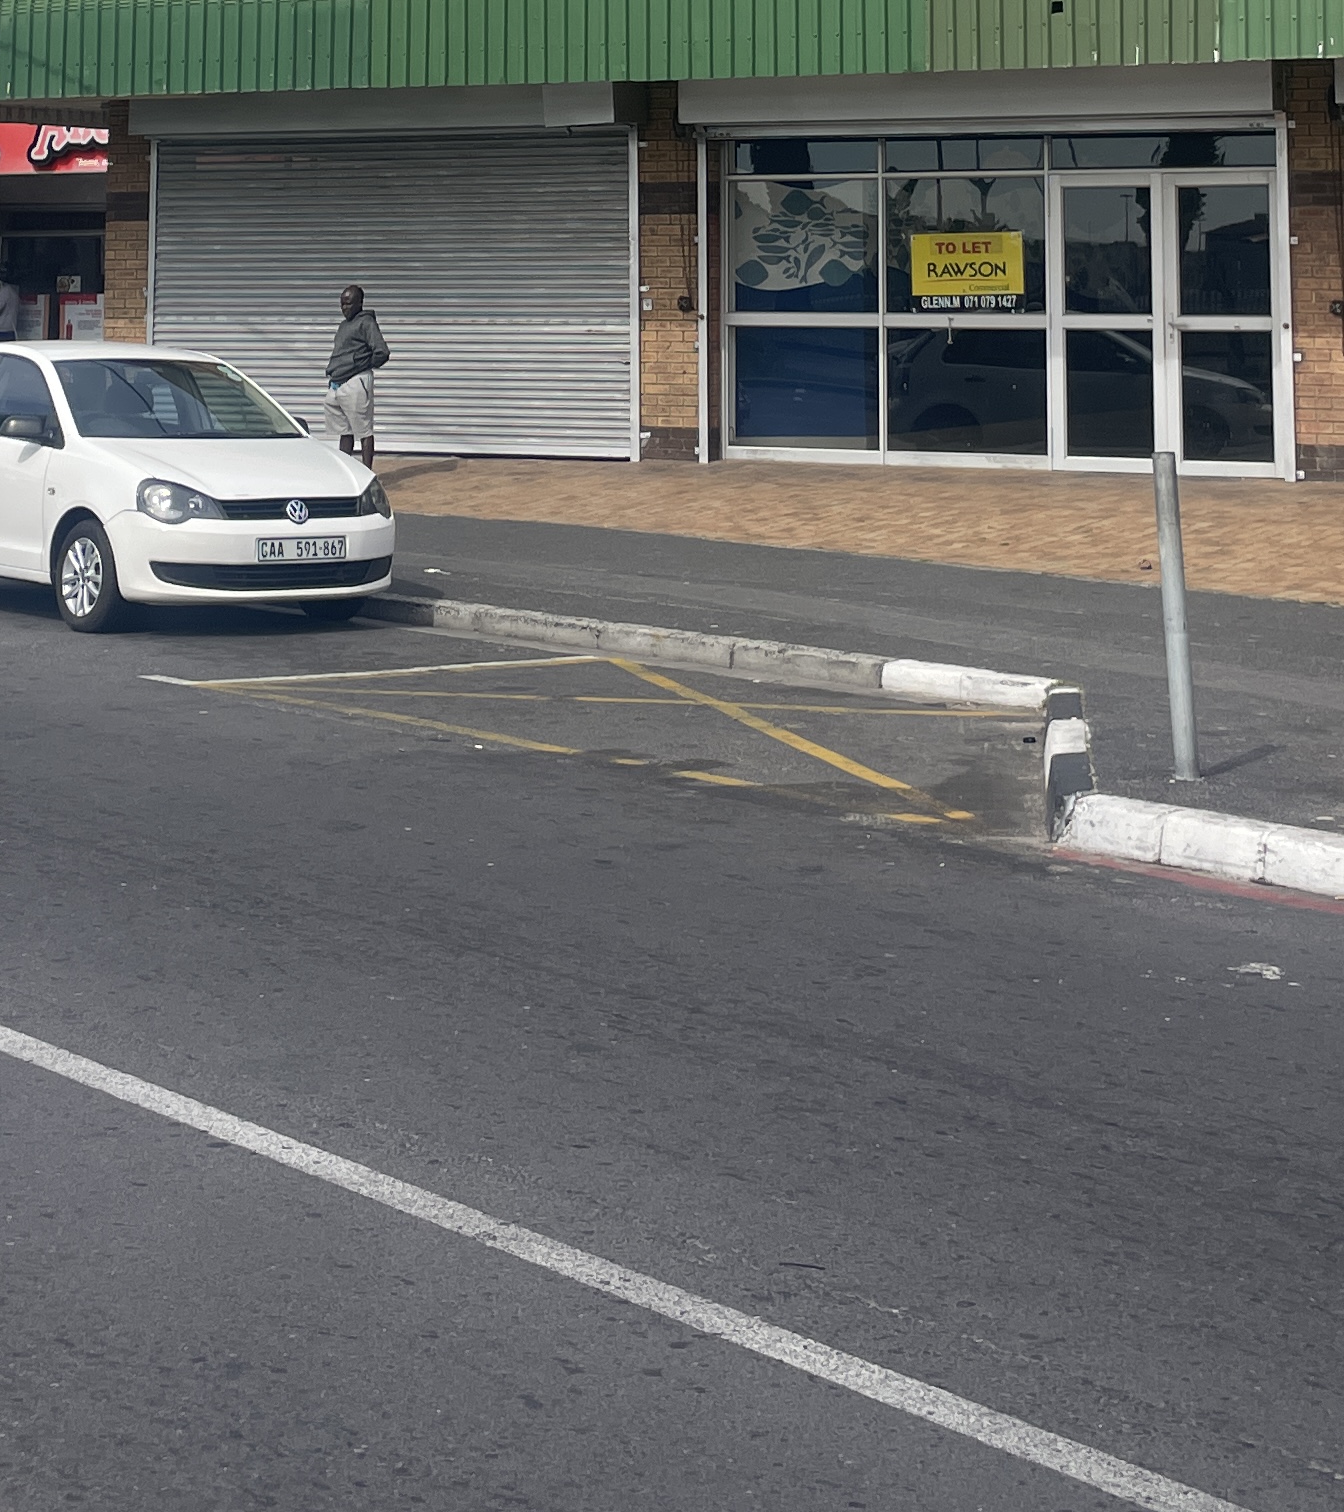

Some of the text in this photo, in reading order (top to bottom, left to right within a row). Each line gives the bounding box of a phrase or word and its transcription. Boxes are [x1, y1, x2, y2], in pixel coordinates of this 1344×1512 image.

[935, 241, 991, 254] TO LET
[927, 261, 1006, 277] RAWSON
[964, 296, 978, 307] 071
[981, 296, 996, 307] 079
[997, 295, 1017, 307] 1427
[261, 540, 344, 558] CAA 591-867
